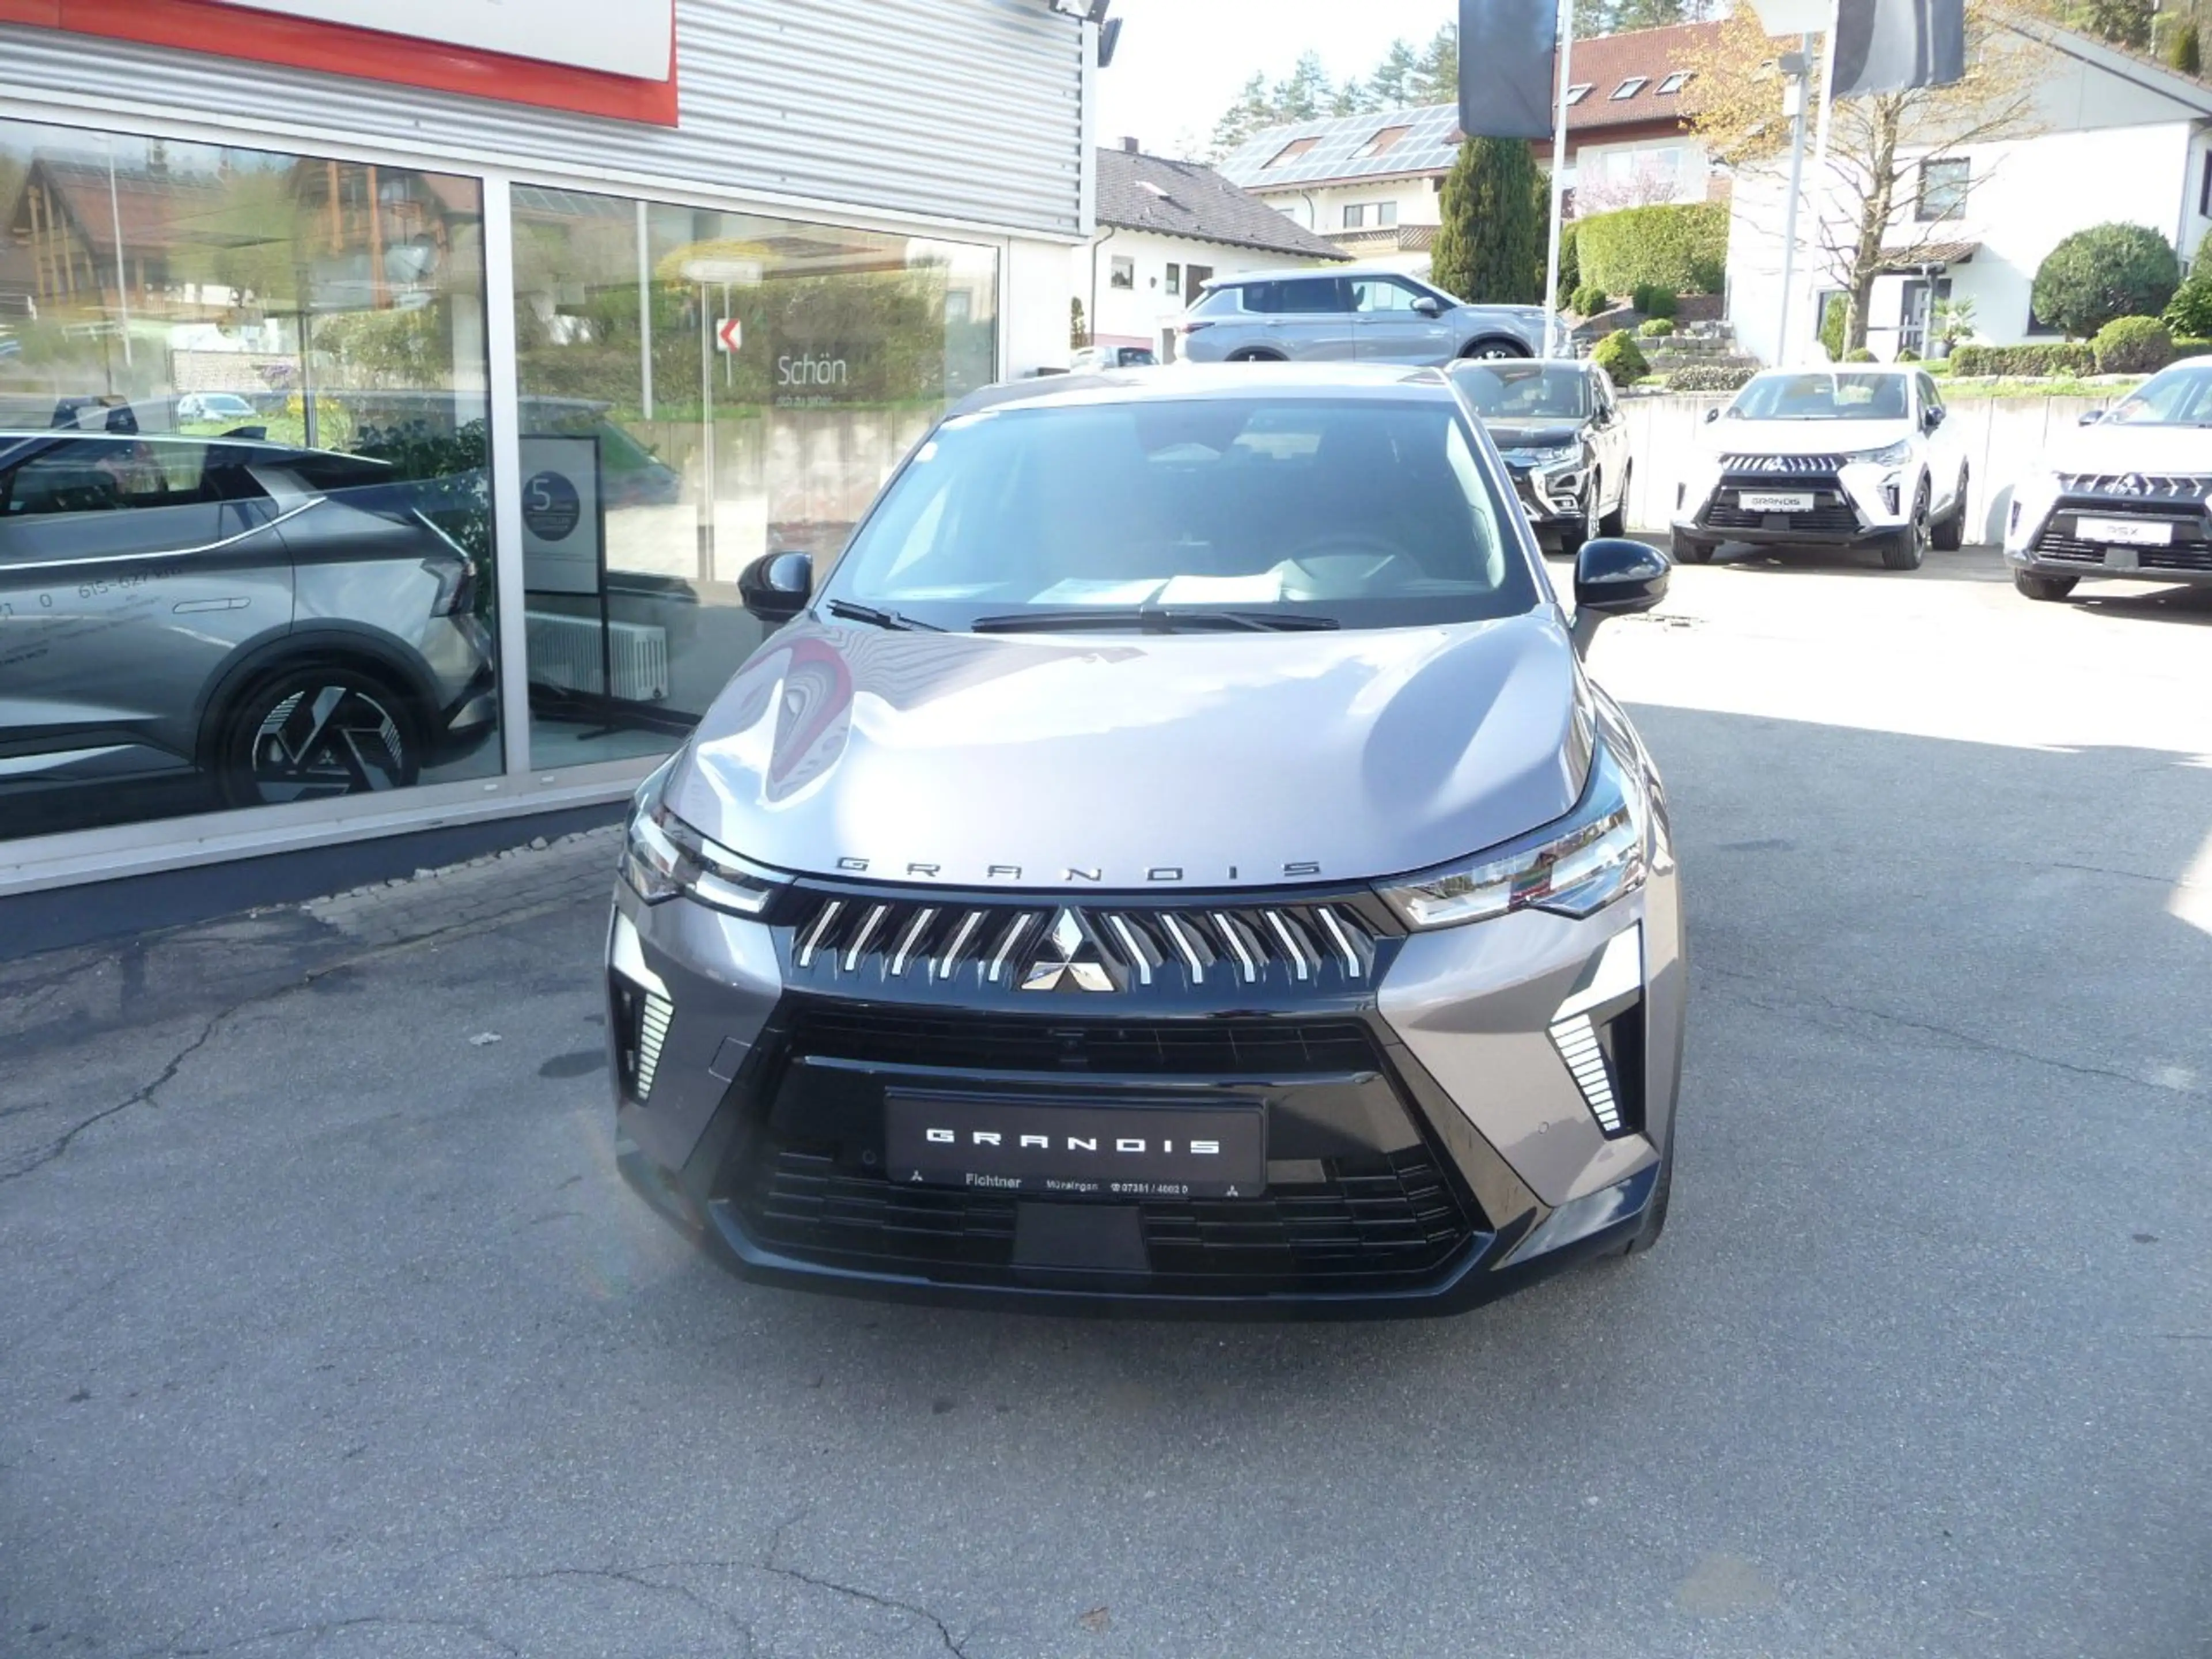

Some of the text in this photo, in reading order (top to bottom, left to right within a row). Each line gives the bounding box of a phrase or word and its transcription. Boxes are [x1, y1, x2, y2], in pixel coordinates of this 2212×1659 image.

[778, 352, 846, 385] Schön
[533, 479, 550, 510] 5
[1752, 498, 1801, 506] GRANDIS
[836, 857, 1321, 881] GRANDIS
[926, 1128, 1219, 1154] GRANDIS
[965, 1173, 1022, 1188] Fichtner
